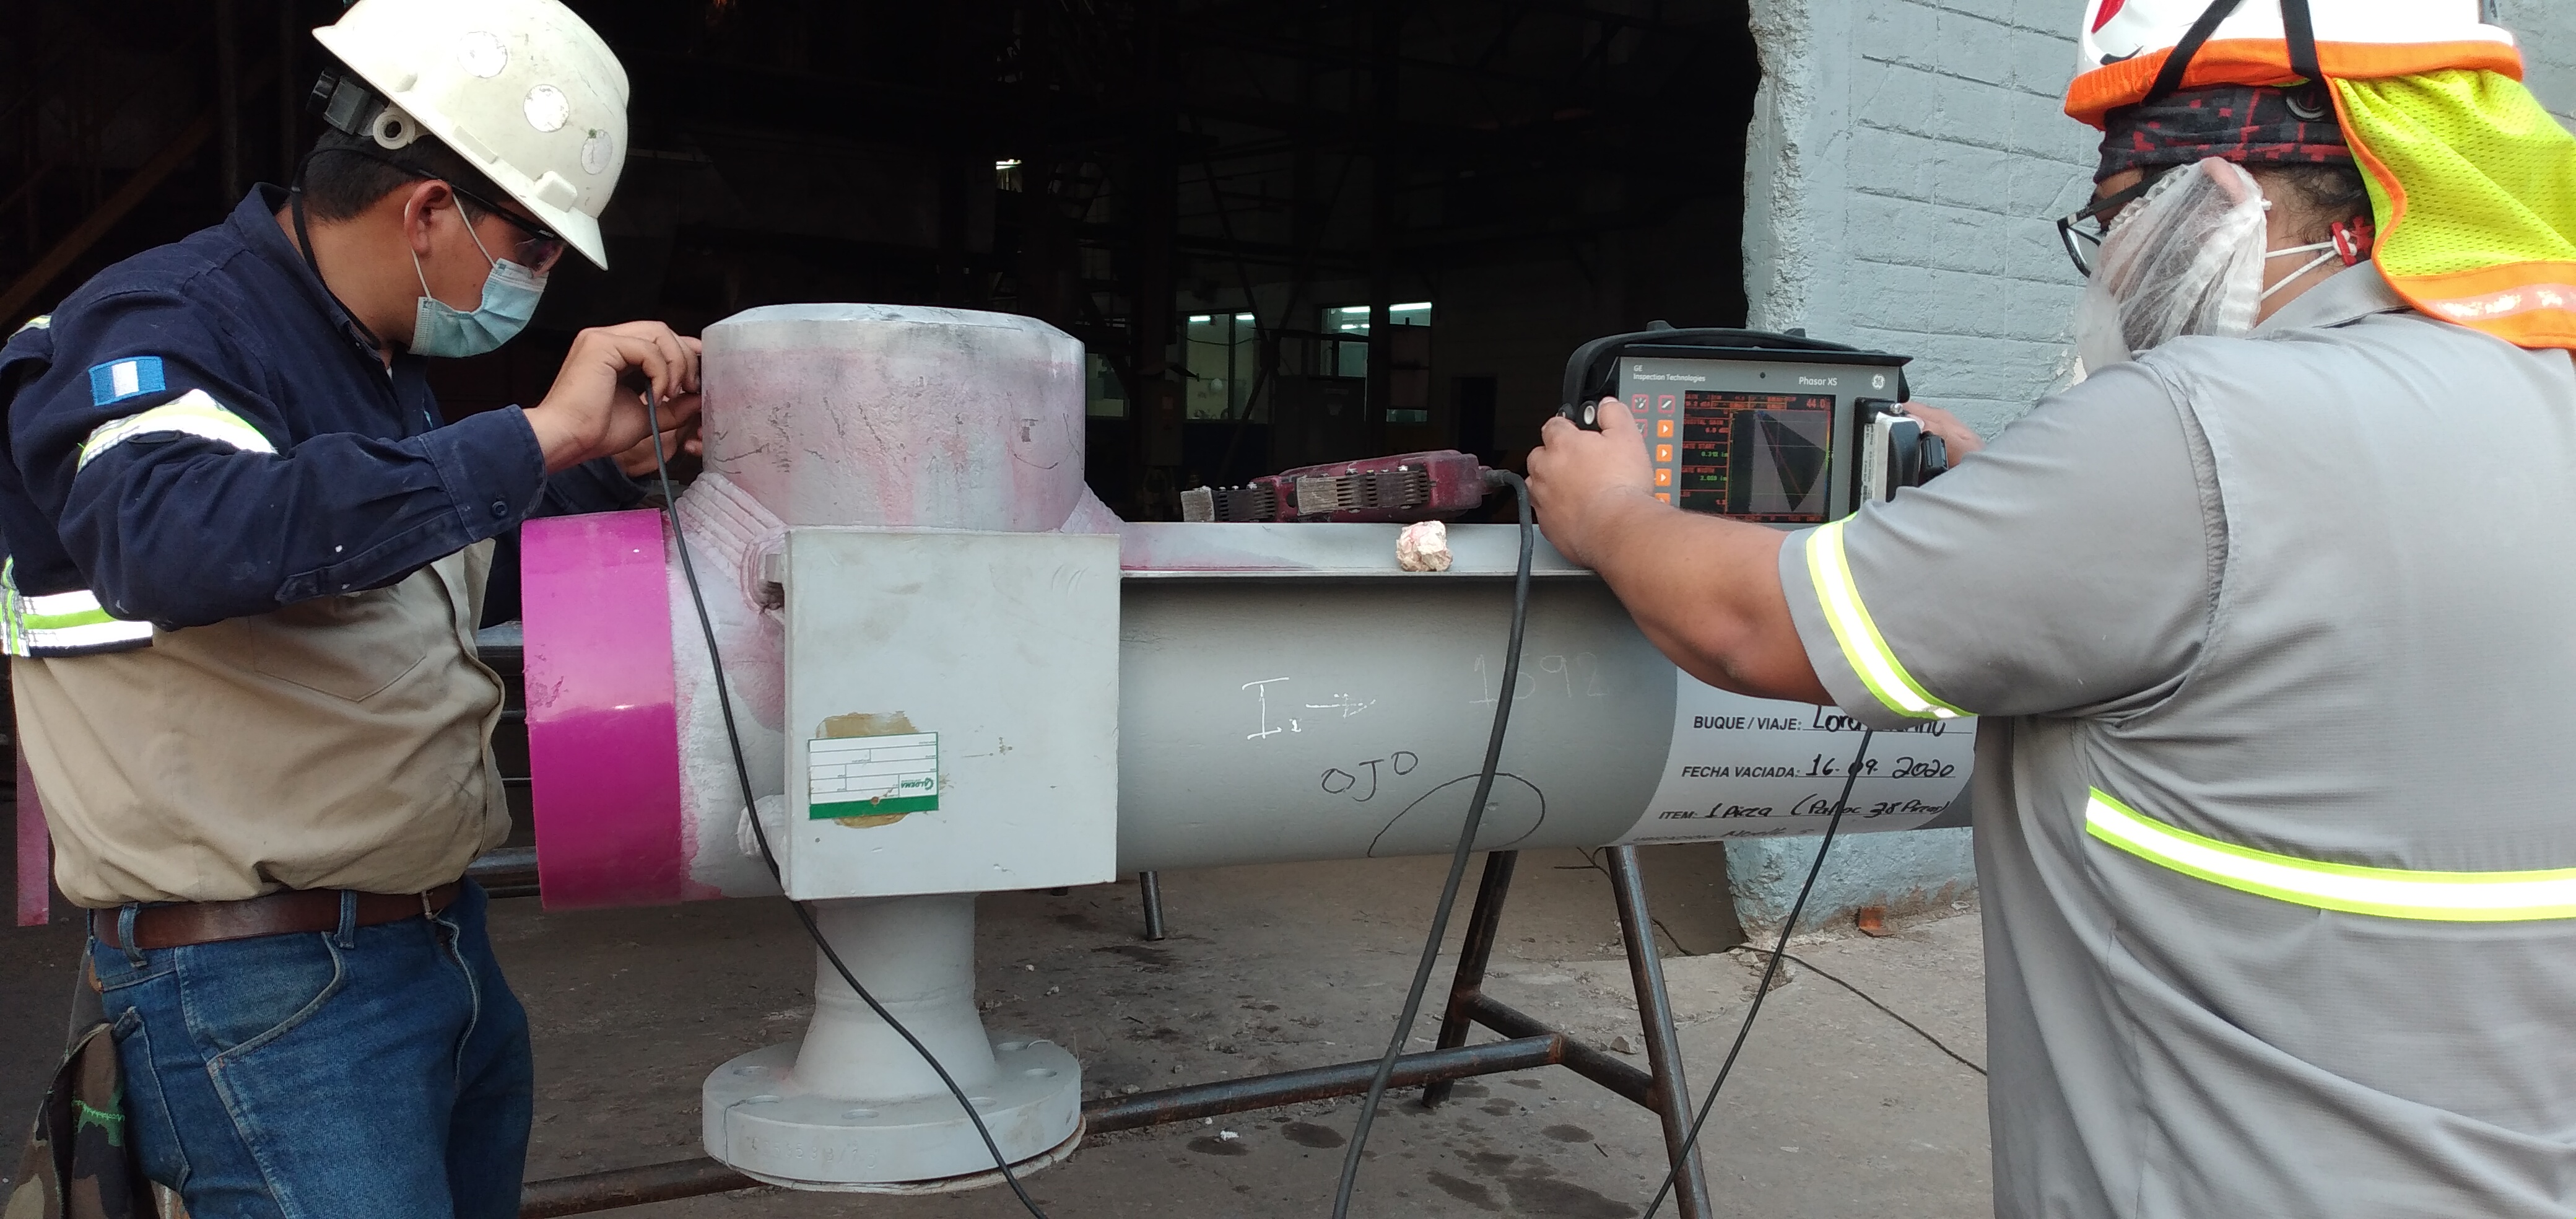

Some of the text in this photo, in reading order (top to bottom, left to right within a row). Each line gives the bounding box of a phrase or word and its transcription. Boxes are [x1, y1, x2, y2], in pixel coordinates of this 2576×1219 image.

[1633, 373, 1706, 383] Inspection Technologies
[1798, 376, 1838, 386] Phasor XS
[1694, 716, 1746, 730] BUQUE
[1757, 717, 1802, 731] VIAJE:
[1681, 766, 1730, 778] FECHA
[1735, 766, 1801, 778] VACIADA:
[1892, 756, 1955, 779] 2020
[1658, 811, 1698, 820] ITEM:
